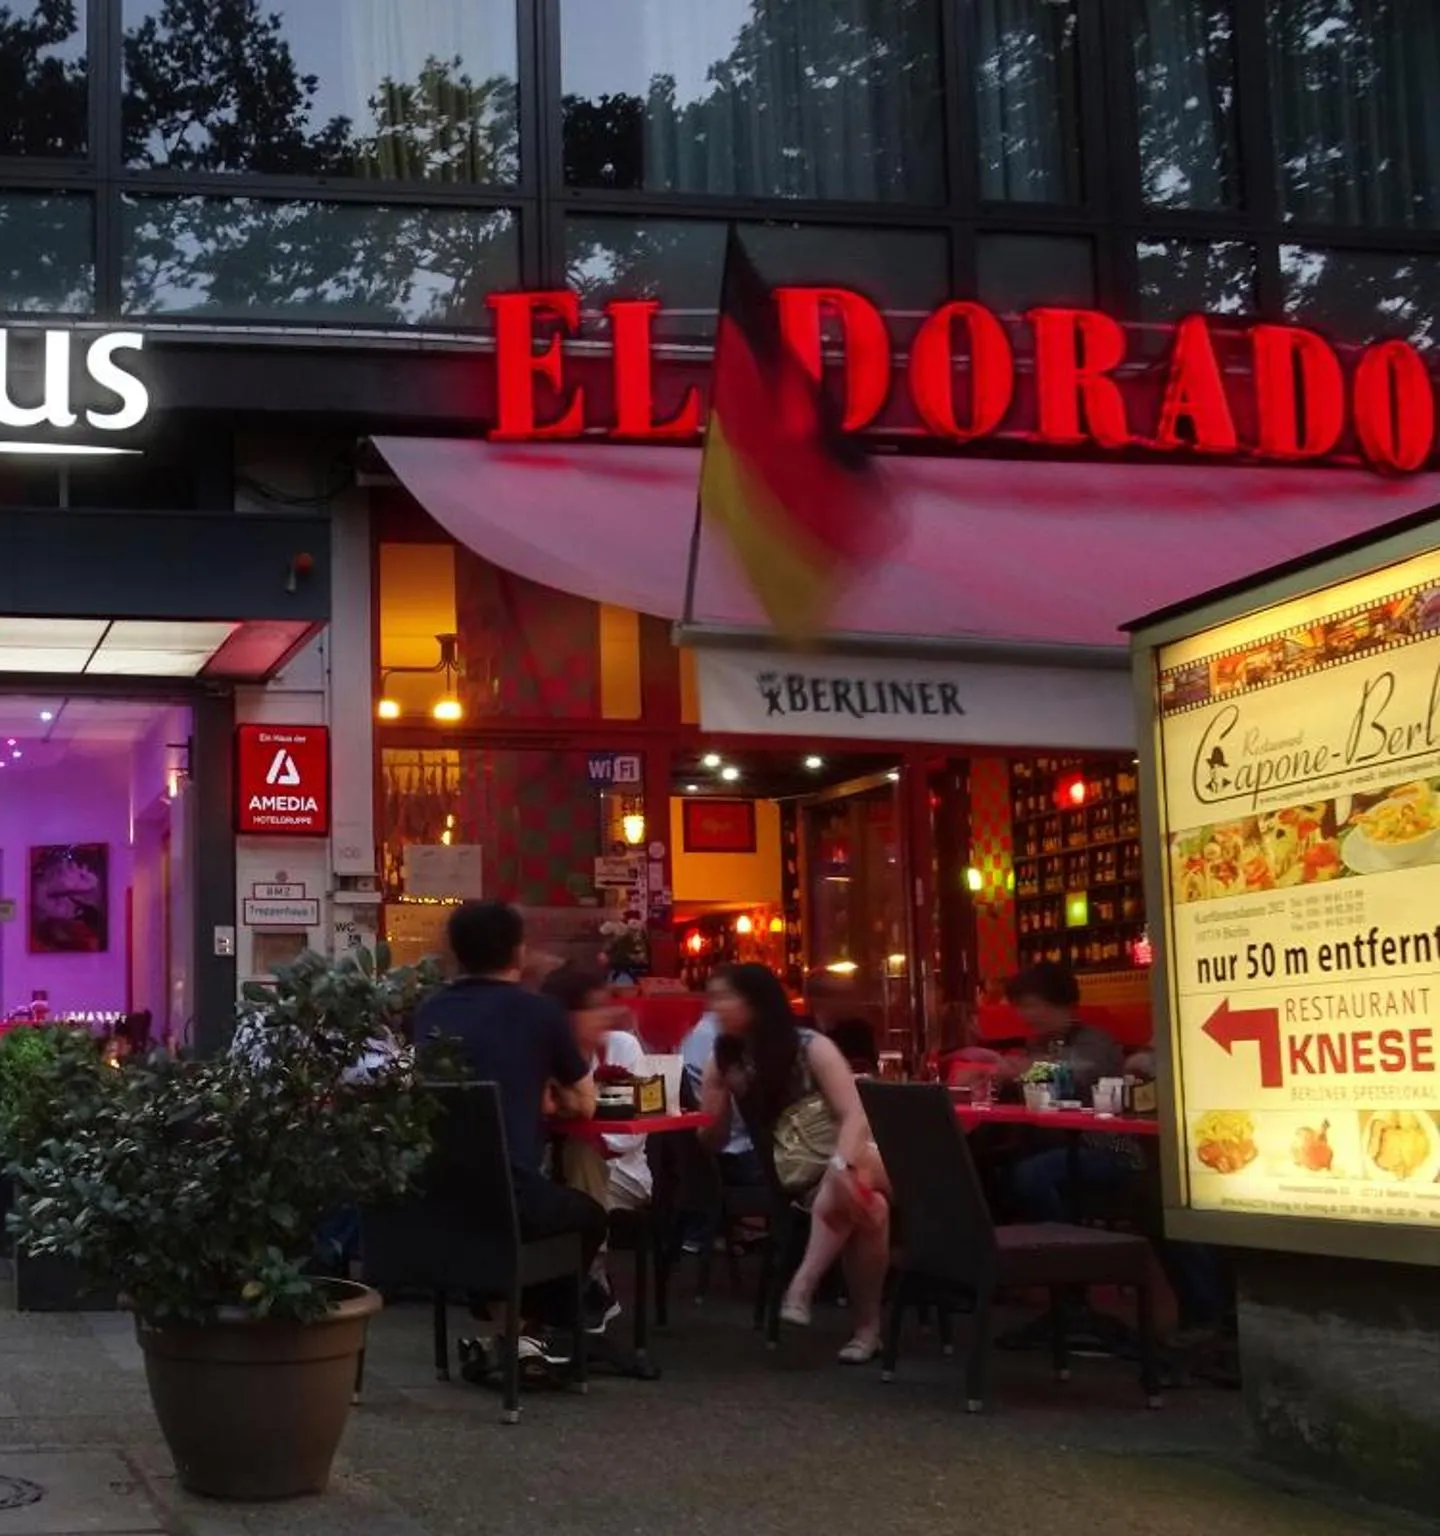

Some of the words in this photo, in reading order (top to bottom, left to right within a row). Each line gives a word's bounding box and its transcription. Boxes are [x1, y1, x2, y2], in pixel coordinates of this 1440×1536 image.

[485, 290, 701, 442] EL
[774, 286, 1434, 472] DORADO
[786, 673, 966, 719] BERLINER
[248, 795, 319, 812] AMEDIA
[252, 815, 313, 825] HOTELGRUPPE
[335, 921, 356, 934] WC
[1197, 953, 1238, 984] nur
[1247, 942, 1276, 980] 50
[1284, 946, 1309, 976] m
[1285, 987, 1431, 1023] RESTAURANT
[1288, 1028, 1435, 1075] KNESE
